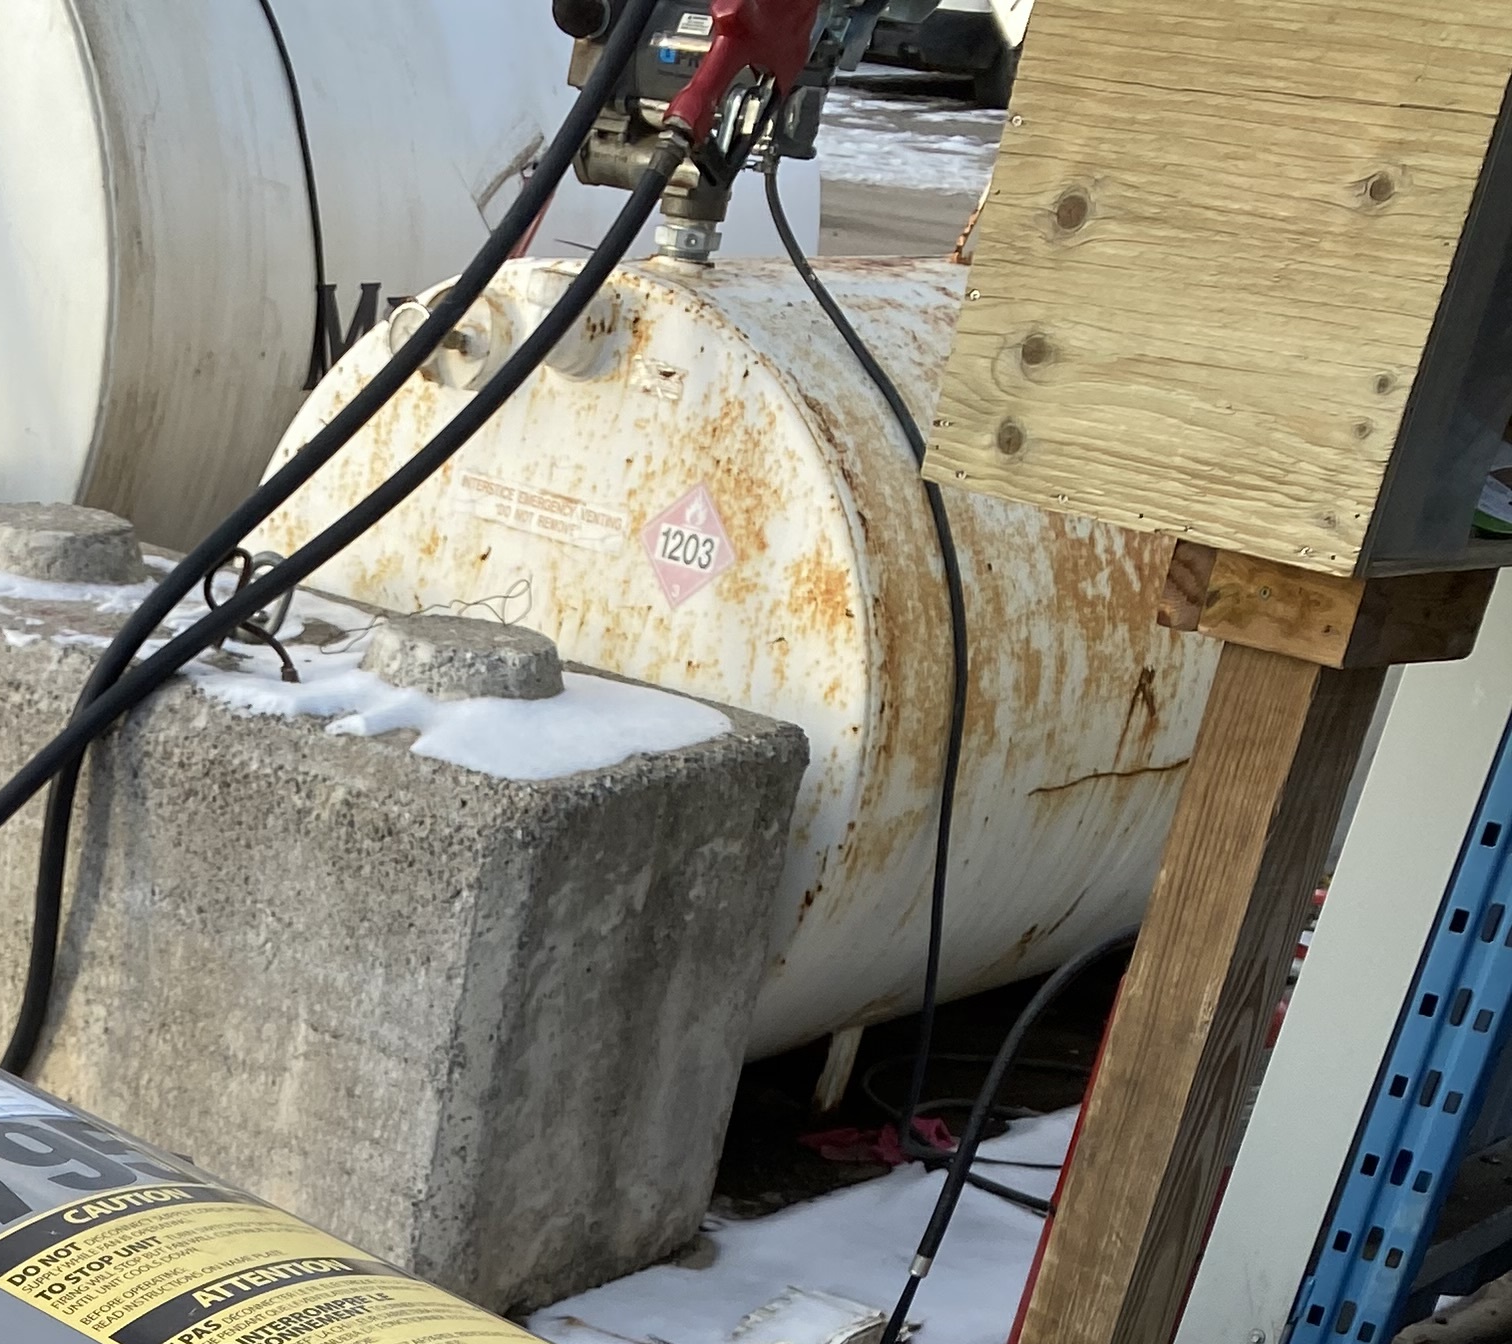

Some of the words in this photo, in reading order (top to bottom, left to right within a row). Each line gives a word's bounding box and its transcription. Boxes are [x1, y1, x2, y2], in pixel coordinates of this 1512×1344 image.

[580, 506, 623, 531] VENTING
[659, 527, 715, 570] 1203
[671, 584, 680, 598] 3
[63, 1188, 194, 1224] CAUTION
[7, 1265, 41, 1285] DO
[37, 1242, 82, 1267] NOT
[22, 1267, 63, 1292] SUPPLY
[58, 1249, 99, 1269] WHILE
[96, 1239, 122, 1251] FAN
[35, 1283, 67, 1301] TO
[64, 1255, 114, 1284] STOP
[114, 1236, 162, 1258] UNIT
[51, 1284, 90, 1308] FIRING
[86, 1271, 116, 1286] WILL
[113, 1256, 142, 1272] STOP
[141, 1247, 167, 1259] BUT
[192, 1257, 353, 1308] ATTENTION
[62, 1294, 99, 1315] UNTIL
[94, 1277, 124, 1295] UNIT
[123, 1259, 163, 1280] COOLS
[91, 1310, 125, 1332] READ
[122, 1271, 203, 1312] INSTRUCTIONS
[201, 1265, 222, 1274] ON
[366, 1292, 395, 1302] LE
[79, 1297, 125, 1325] BEFORE
[216, 1313, 266, 1340] PENDANT
[314, 1330, 334, 1339] LA
